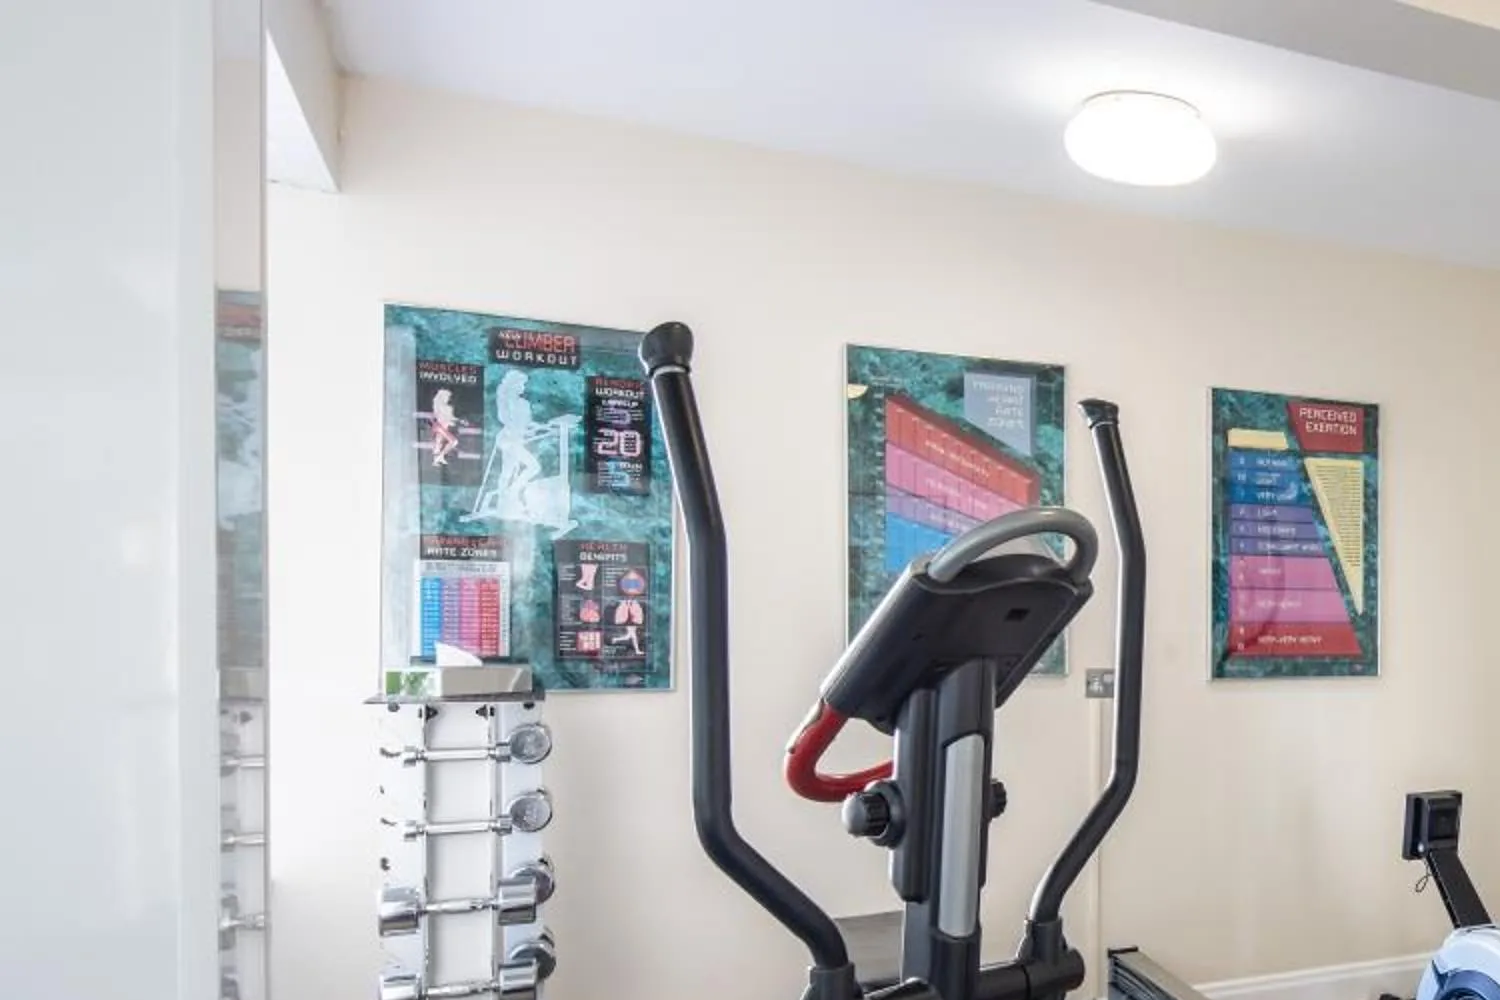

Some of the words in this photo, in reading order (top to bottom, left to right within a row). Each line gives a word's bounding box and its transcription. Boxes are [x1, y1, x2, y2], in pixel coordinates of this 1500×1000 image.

[496, 350, 577, 365] WORKOUT
[595, 387, 645, 398] WORKOUT
[1299, 407, 1357, 423] PERCEIVED
[1305, 421, 1357, 435] EXERTION
[597, 424, 641, 457] 20
